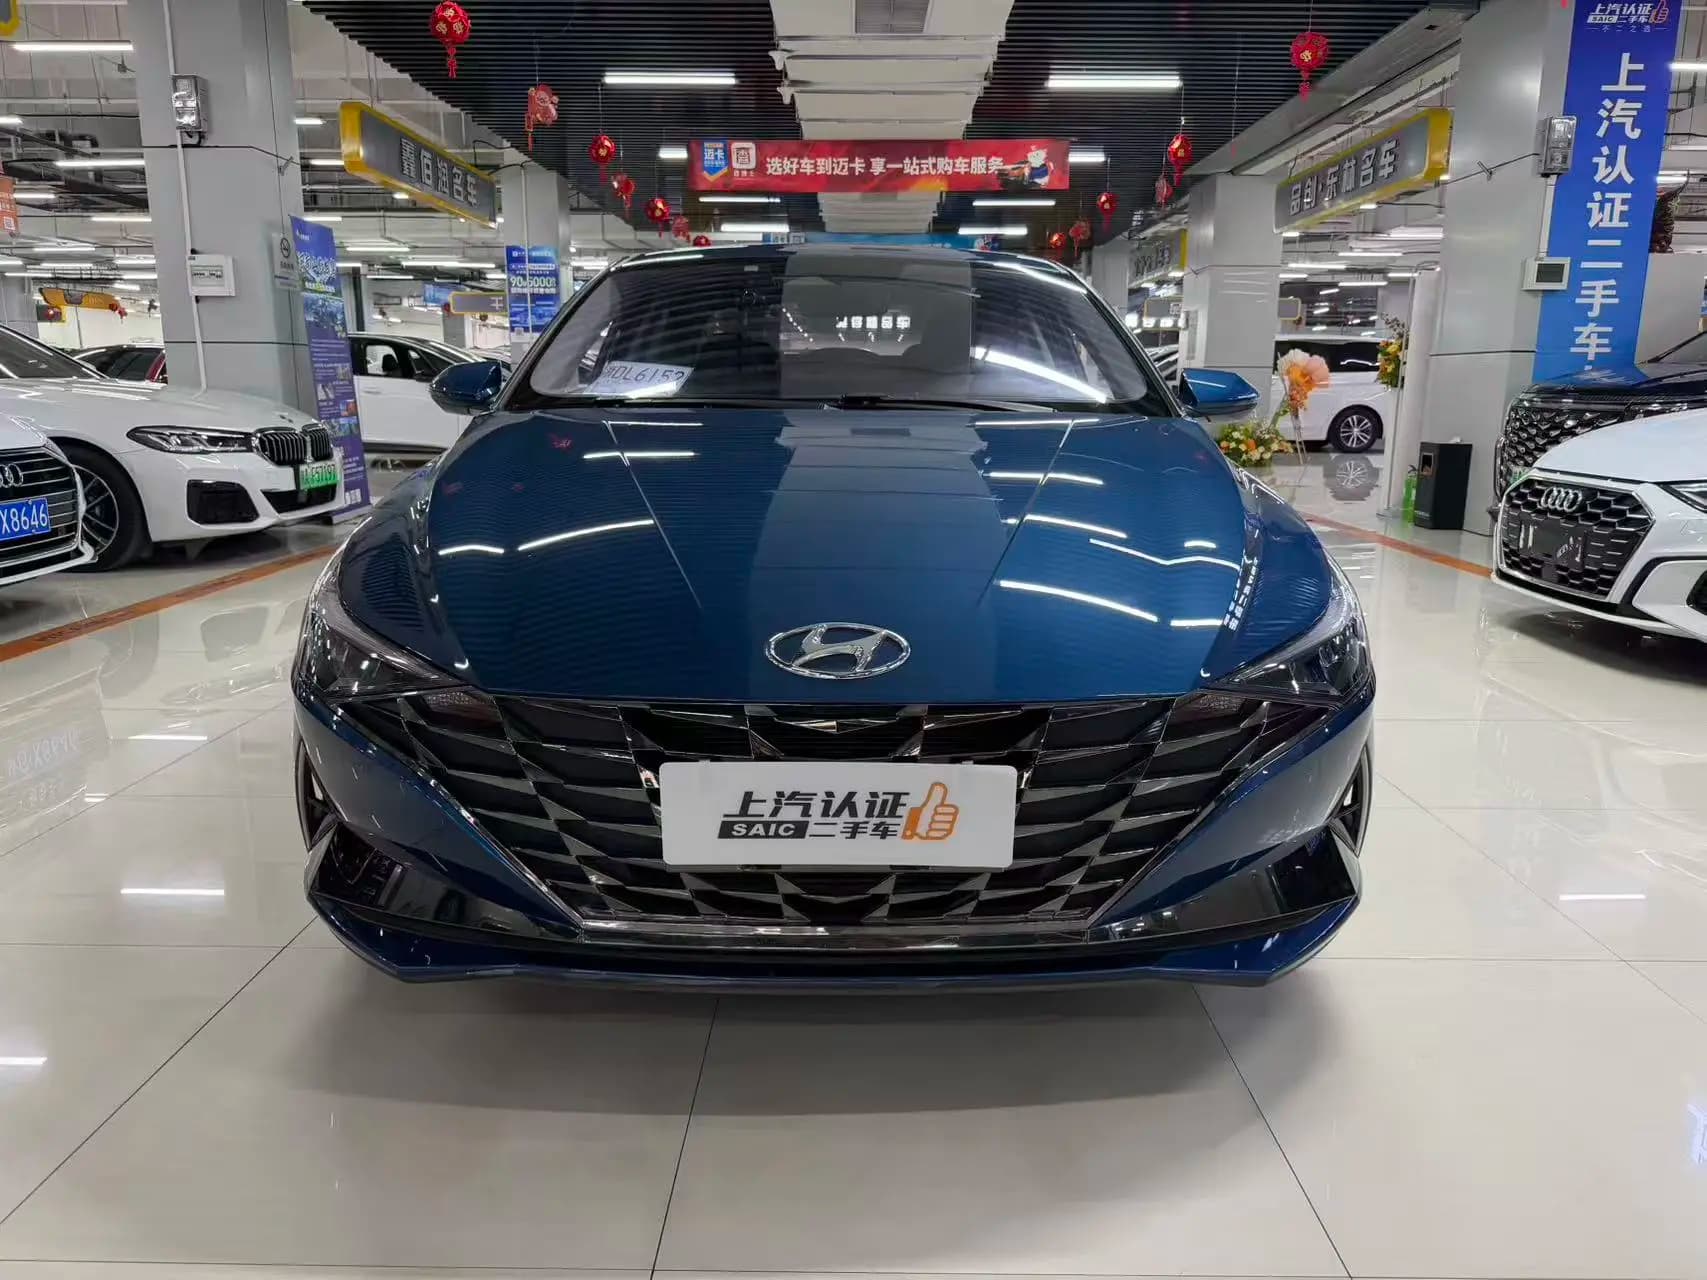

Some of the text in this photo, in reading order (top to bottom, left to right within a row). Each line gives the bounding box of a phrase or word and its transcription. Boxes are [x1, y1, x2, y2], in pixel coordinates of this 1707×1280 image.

[1592, 3, 1654, 15] 上汽认证
[703, 149, 725, 161] 迈卡
[766, 156, 1004, 176] 选好车到迈卡 享一站式购车服务
[1569, 52, 1646, 361] 上汽认证二手车
[722, 790, 911, 818] 上汽认证
[730, 823, 797, 837] SAIC
[809, 821, 902, 840] 二手车
